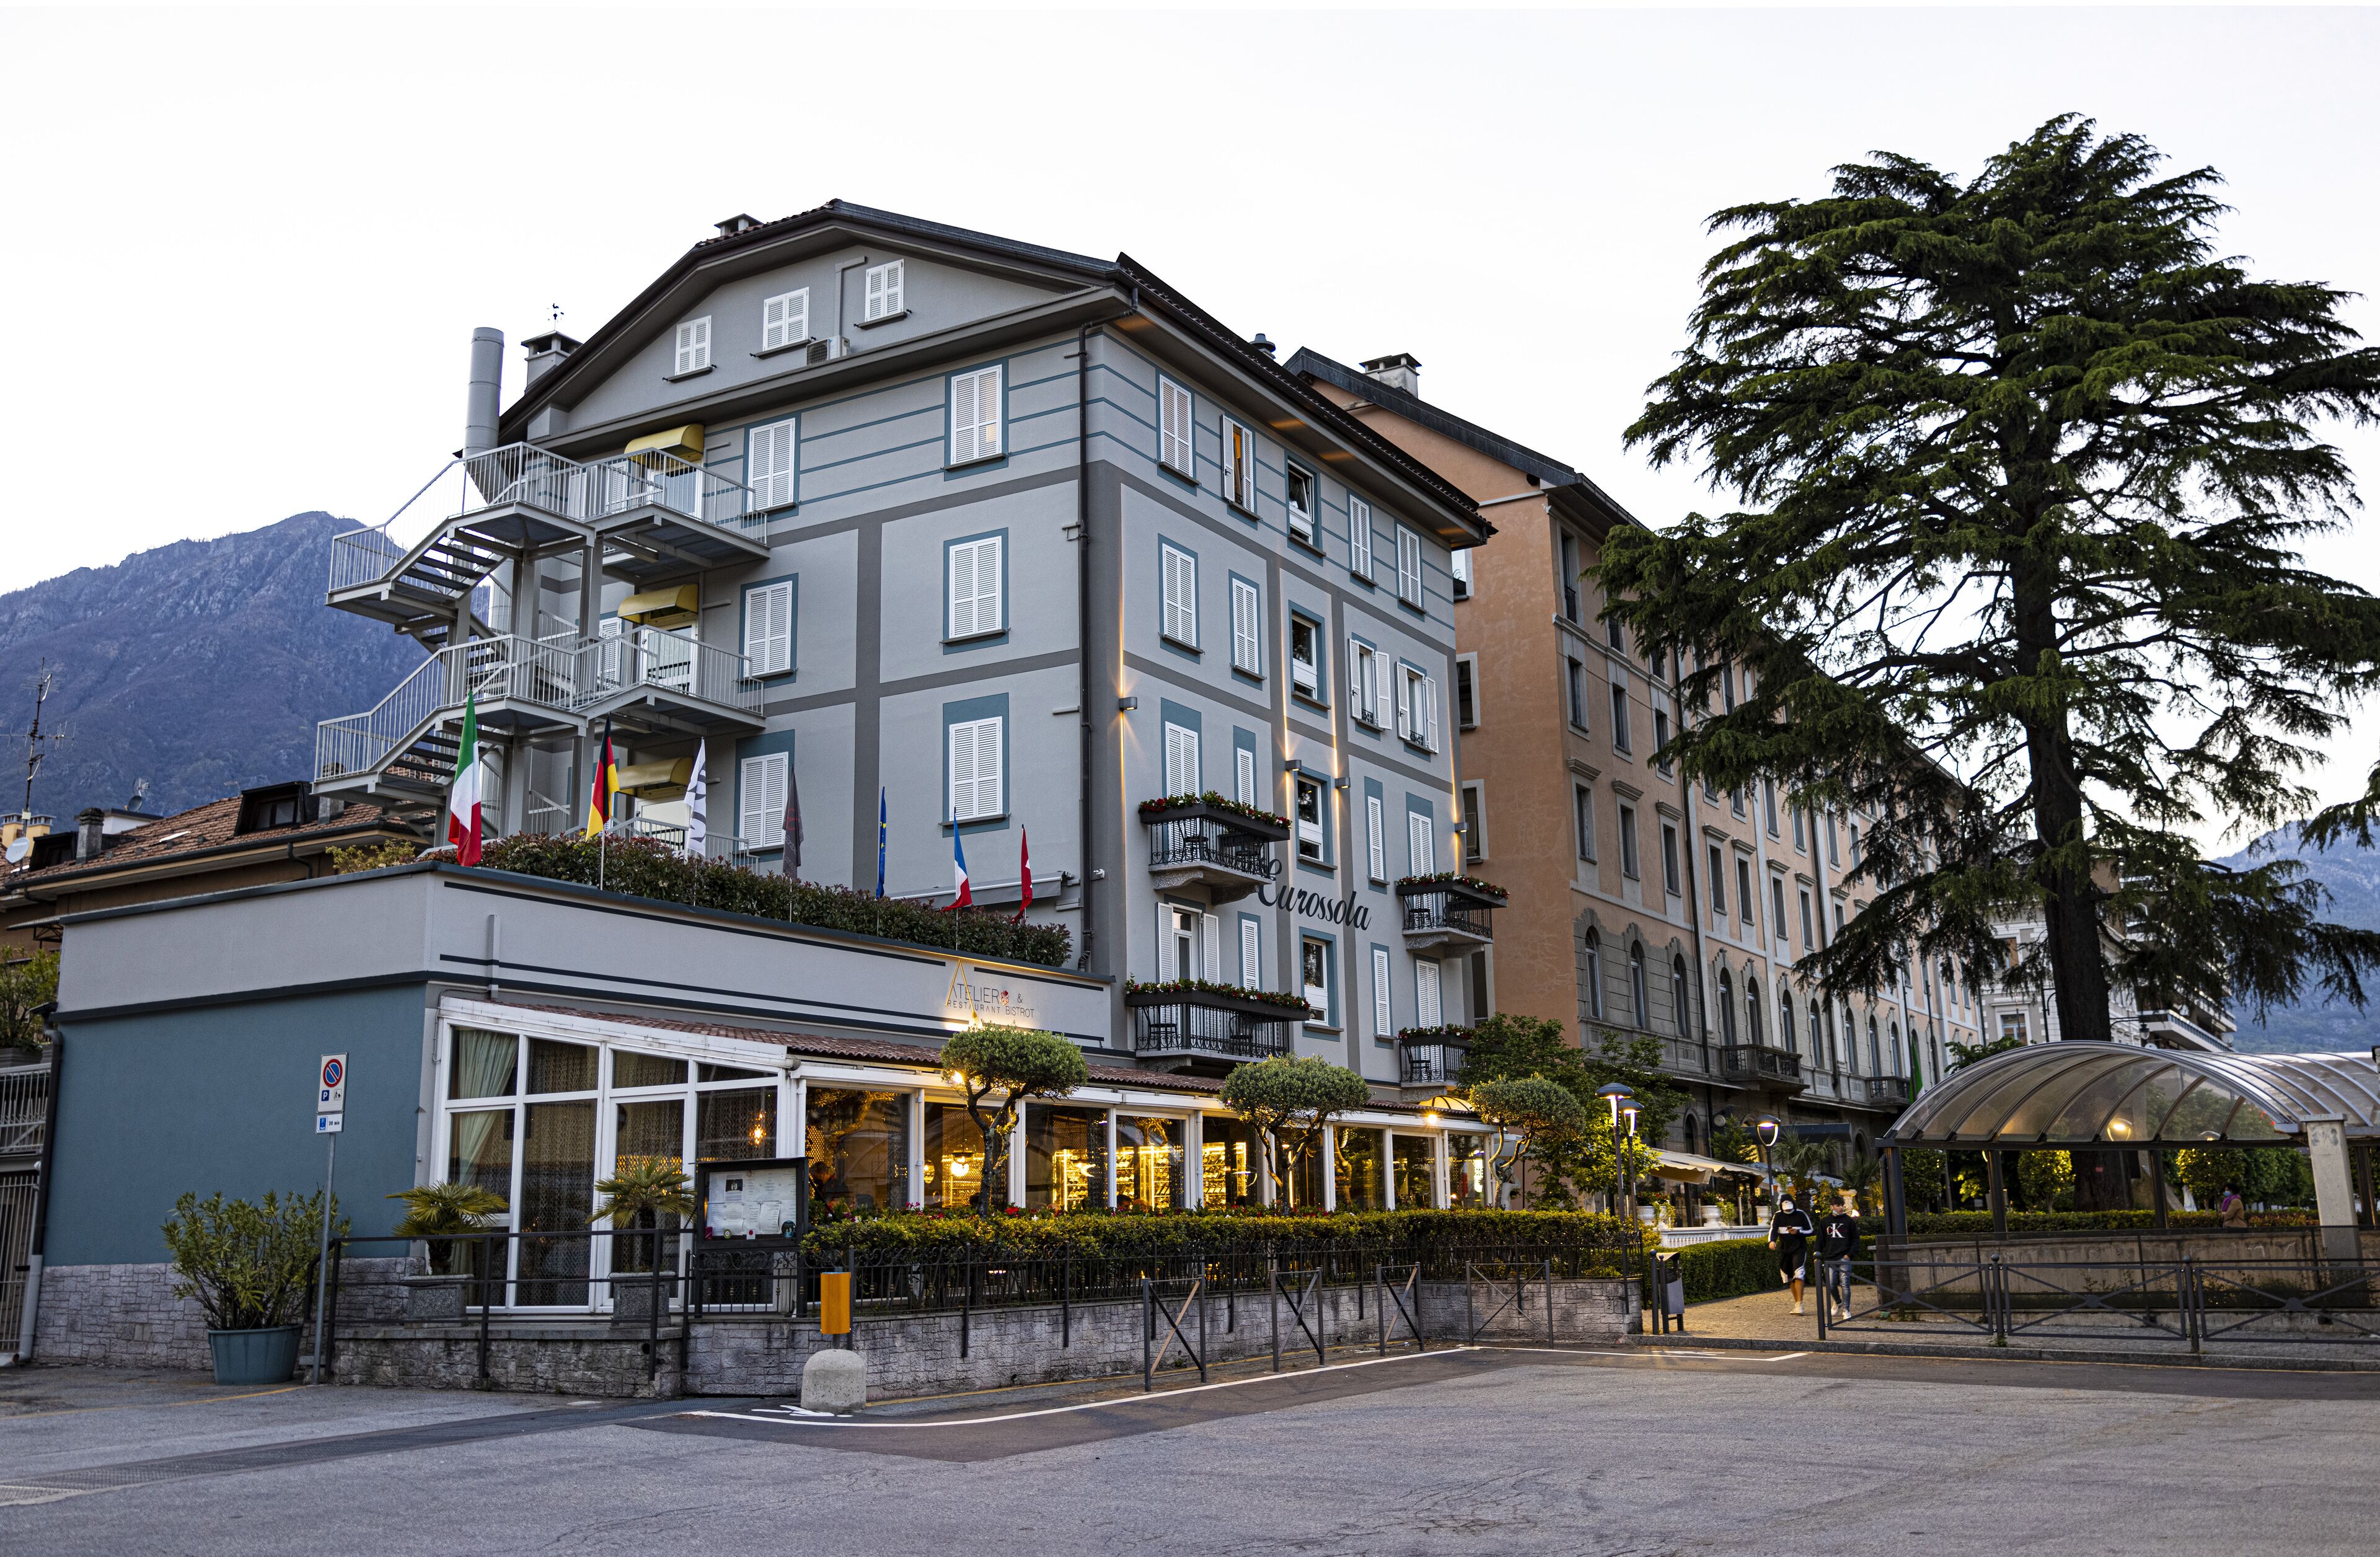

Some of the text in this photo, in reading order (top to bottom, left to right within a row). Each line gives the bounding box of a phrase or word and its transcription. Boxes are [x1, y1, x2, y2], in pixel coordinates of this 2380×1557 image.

[1258, 858, 1372, 930] Eurossola
[947, 982, 1023, 1004] ATELIER &
[1005, 1005, 1034, 1018] BISTROT
